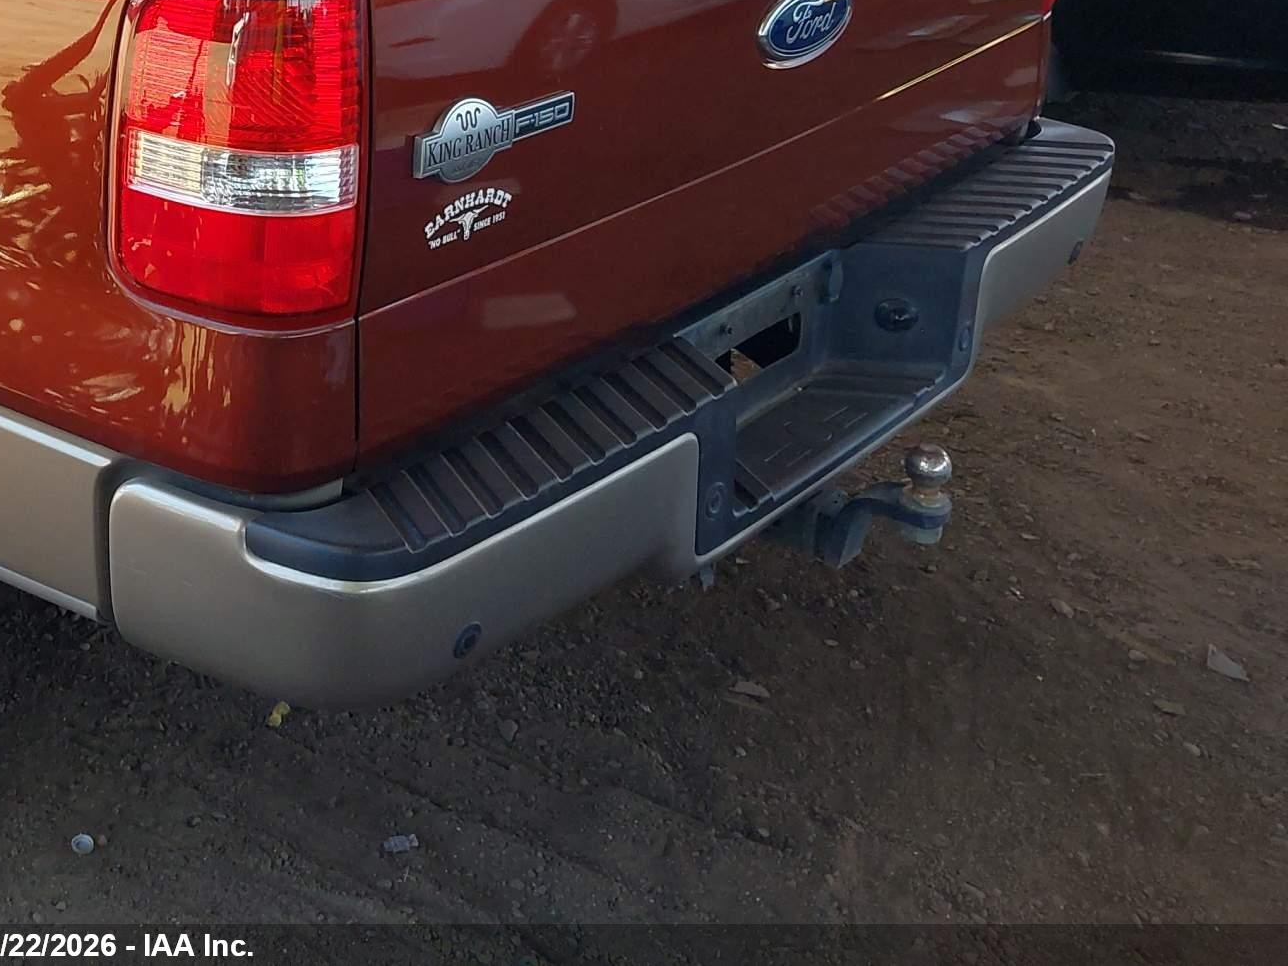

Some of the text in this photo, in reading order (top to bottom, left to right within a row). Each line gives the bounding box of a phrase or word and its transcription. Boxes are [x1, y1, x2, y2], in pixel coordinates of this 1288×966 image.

[515, 101, 570, 134] F-150
[427, 137, 461, 167] KING
[465, 117, 511, 155] RANCH
[425, 187, 512, 239] EARNHARDT
[473, 216, 491, 232] SINCE
